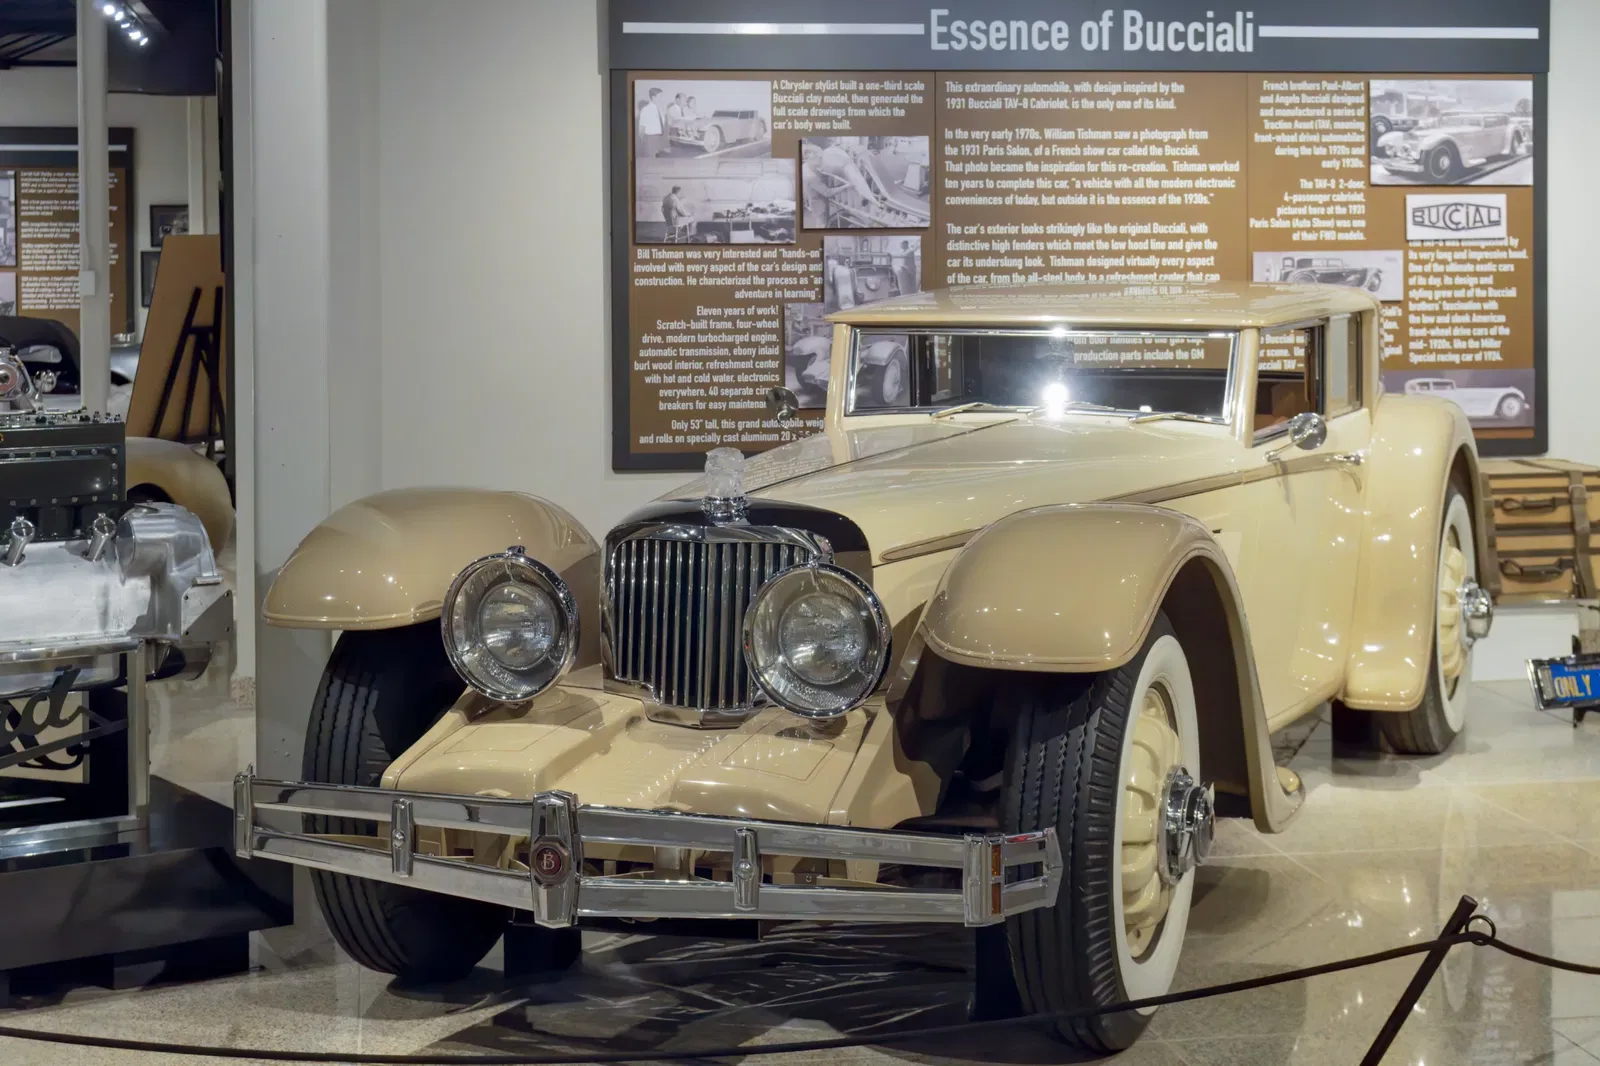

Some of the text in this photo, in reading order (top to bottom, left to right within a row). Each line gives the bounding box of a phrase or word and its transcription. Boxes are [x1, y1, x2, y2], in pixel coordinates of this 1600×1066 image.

[930, 9, 1254, 52] Essence of Bucciali
[773, 80, 925, 92] A Chrysler stylist built a one-third scale
[945, 82, 962, 93] This
[964, 82, 1021, 95] extraordinary
[1074, 82, 1092, 93] with
[1093, 82, 1121, 95] design
[1123, 82, 1157, 95] inspired
[1159, 82, 1169, 95] by
[1171, 82, 1185, 93] the
[773, 93, 804, 103] Bucciali
[806, 93, 822, 106] clay
[851, 94, 868, 104] then
[870, 94, 909, 106] generated
[910, 94, 924, 104] the
[773, 107, 906, 118] full scale drawings from which the
[794, 120, 812, 131] body
[832, 120, 852, 129] built.
[945, 129, 953, 140] In
[955, 129, 968, 140] the
[970, 131, 989, 142] very
[991, 129, 1012, 142] early
[1044, 129, 1075, 140] William
[1078, 129, 1111, 140] Tishman
[1114, 131, 1130, 140] saw
[1132, 131, 1138, 140] a
[1140, 129, 1186, 142] photograph
[1188, 129, 1209, 140] from
[946, 224, 961, 235] The
[987, 223, 1018, 234] exterior
[1021, 223, 1044, 234] looks
[1046, 223, 1085, 237] strikingly
[1087, 223, 1102, 234] like
[1104, 223, 1117, 234] the
[1119, 223, 1151, 236] original
[1190, 223, 1209, 234] with
[637, 249, 650, 259] Bill
[652, 249, 684, 258] Tishman
[703, 251, 720, 260] very
[722, 249, 760, 258] interested
[763, 248, 777, 258] and
[634, 262, 823, 274] involved with every aspect of the car's design and
[947, 256, 1215, 270] car its underslung look. Tishman designed virtually every aspect
[634, 276, 685, 286] construction.
[686, 276, 696, 286] He
[699, 276, 751, 286] characterized
[753, 276, 765, 285] the
[767, 277, 797, 287] process
[799, 277, 808, 285] as
[734, 290, 772, 299] adventure
[774, 289, 782, 299] in
[697, 305, 779, 317] Eleven years of work!
[656, 319, 707, 330] Scratch-built
[736, 319, 780, 329] four-wheel
[666, 333, 695, 343] modern
[697, 333, 749, 345] turbocharged
[639, 347, 677, 357] automatic
[733, 346, 756, 358] ebony
[758, 346, 780, 355] inlaid
[634, 361, 650, 370] burl
[652, 361, 672, 370] wood
[706, 360, 753, 370] refreshment
[755, 360, 780, 369] center
[644, 374, 661, 384] with
[663, 374, 675, 384] hot
[677, 374, 692, 383] and
[694, 374, 710, 383] cold
[737, 373, 780, 382] electronics
[639, 434, 653, 444] and
[655, 434, 673, 444] rolls
[675, 435, 684, 443] on
[686, 433, 720, 445] specially
[723, 432, 739, 442] cast
[741, 432, 779, 442] aluminum
[781, 431, 790, 441] 20
[792, 433, 798, 441] x
[1554, 674, 1592, 698] ONLY
[541, 852, 555, 870] B
